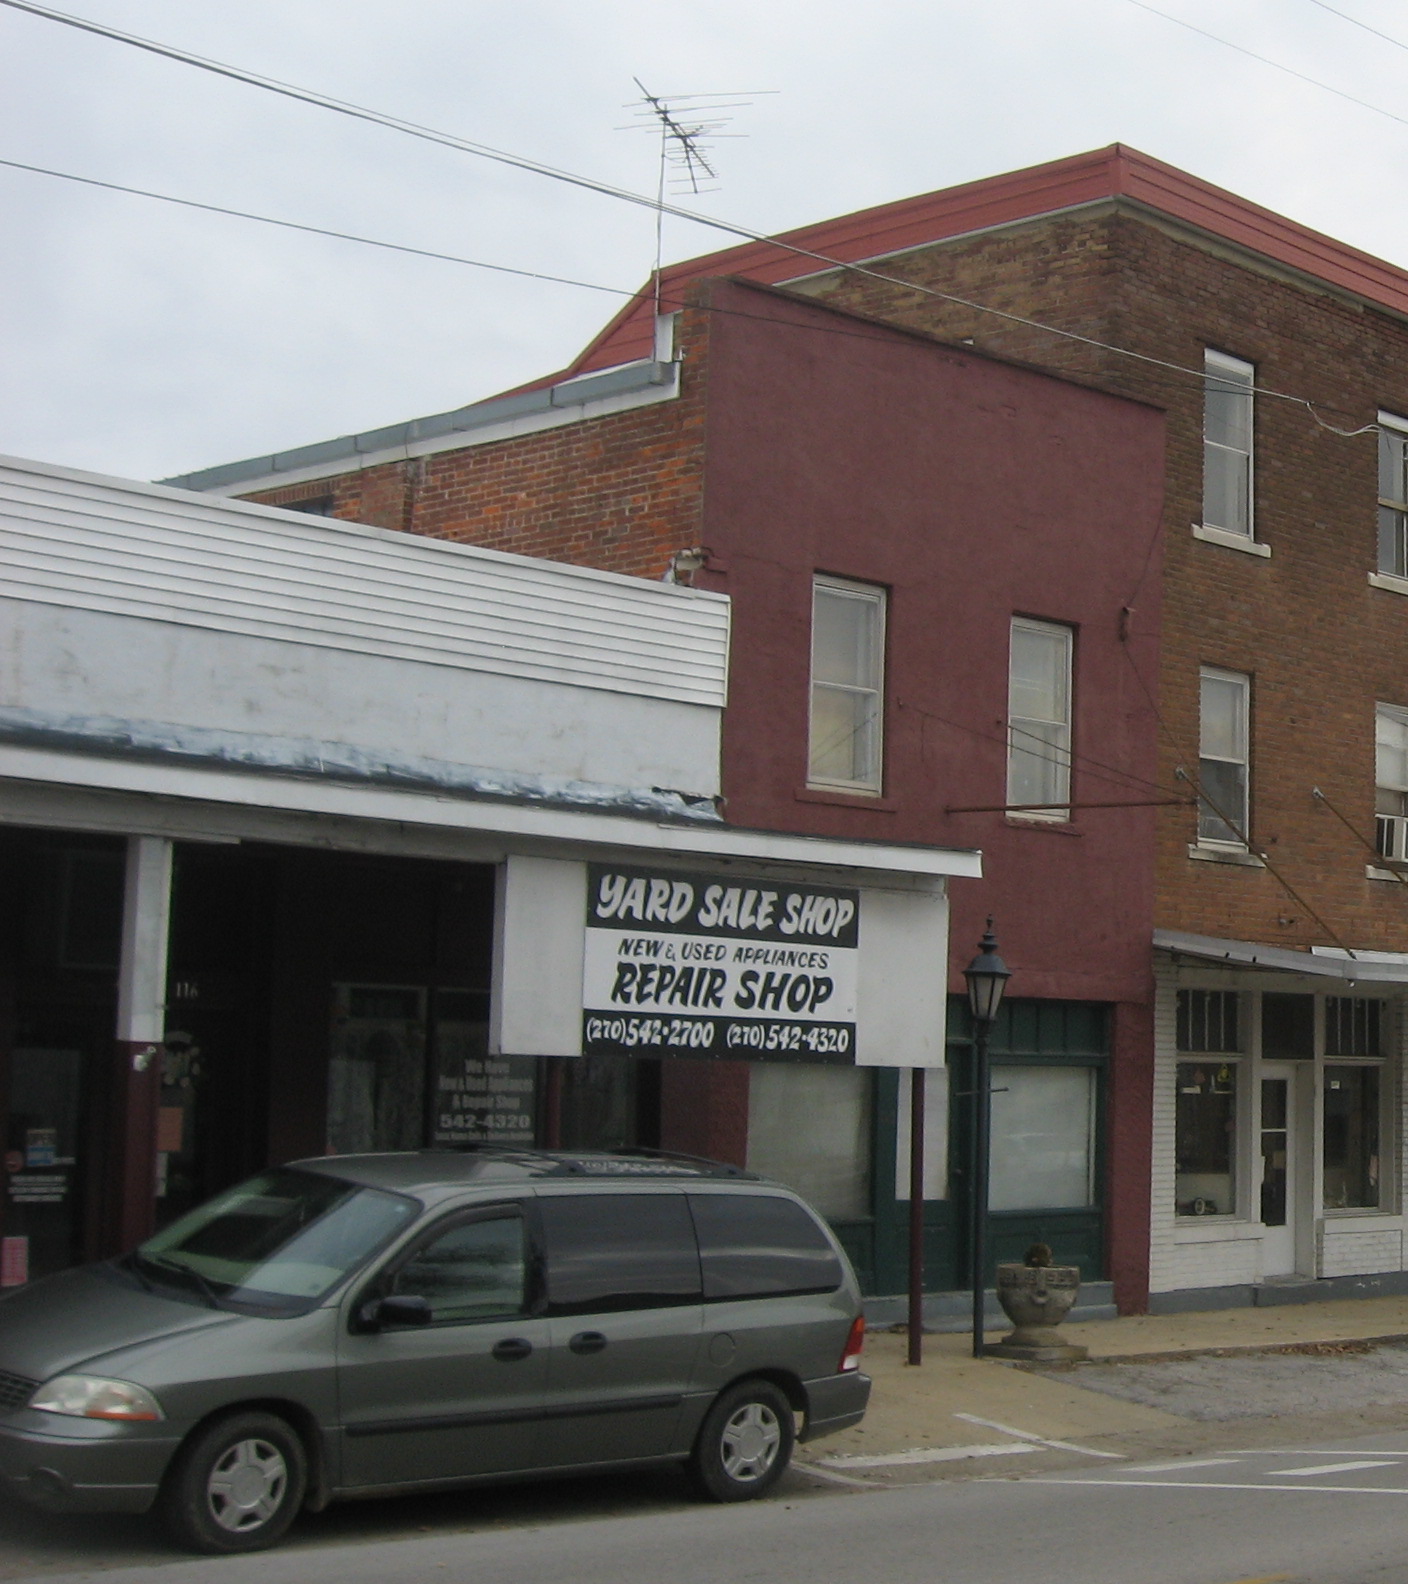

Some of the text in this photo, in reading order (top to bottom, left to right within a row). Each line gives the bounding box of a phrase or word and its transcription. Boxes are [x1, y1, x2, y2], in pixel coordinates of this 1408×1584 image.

[596, 873, 855, 938] YARD SALE SHOP
[618, 937, 830, 970] NEW & USED APPLIANCES
[611, 961, 834, 1014] REPAIR SHOP
[440, 1113, 530, 1128] 542-4320
